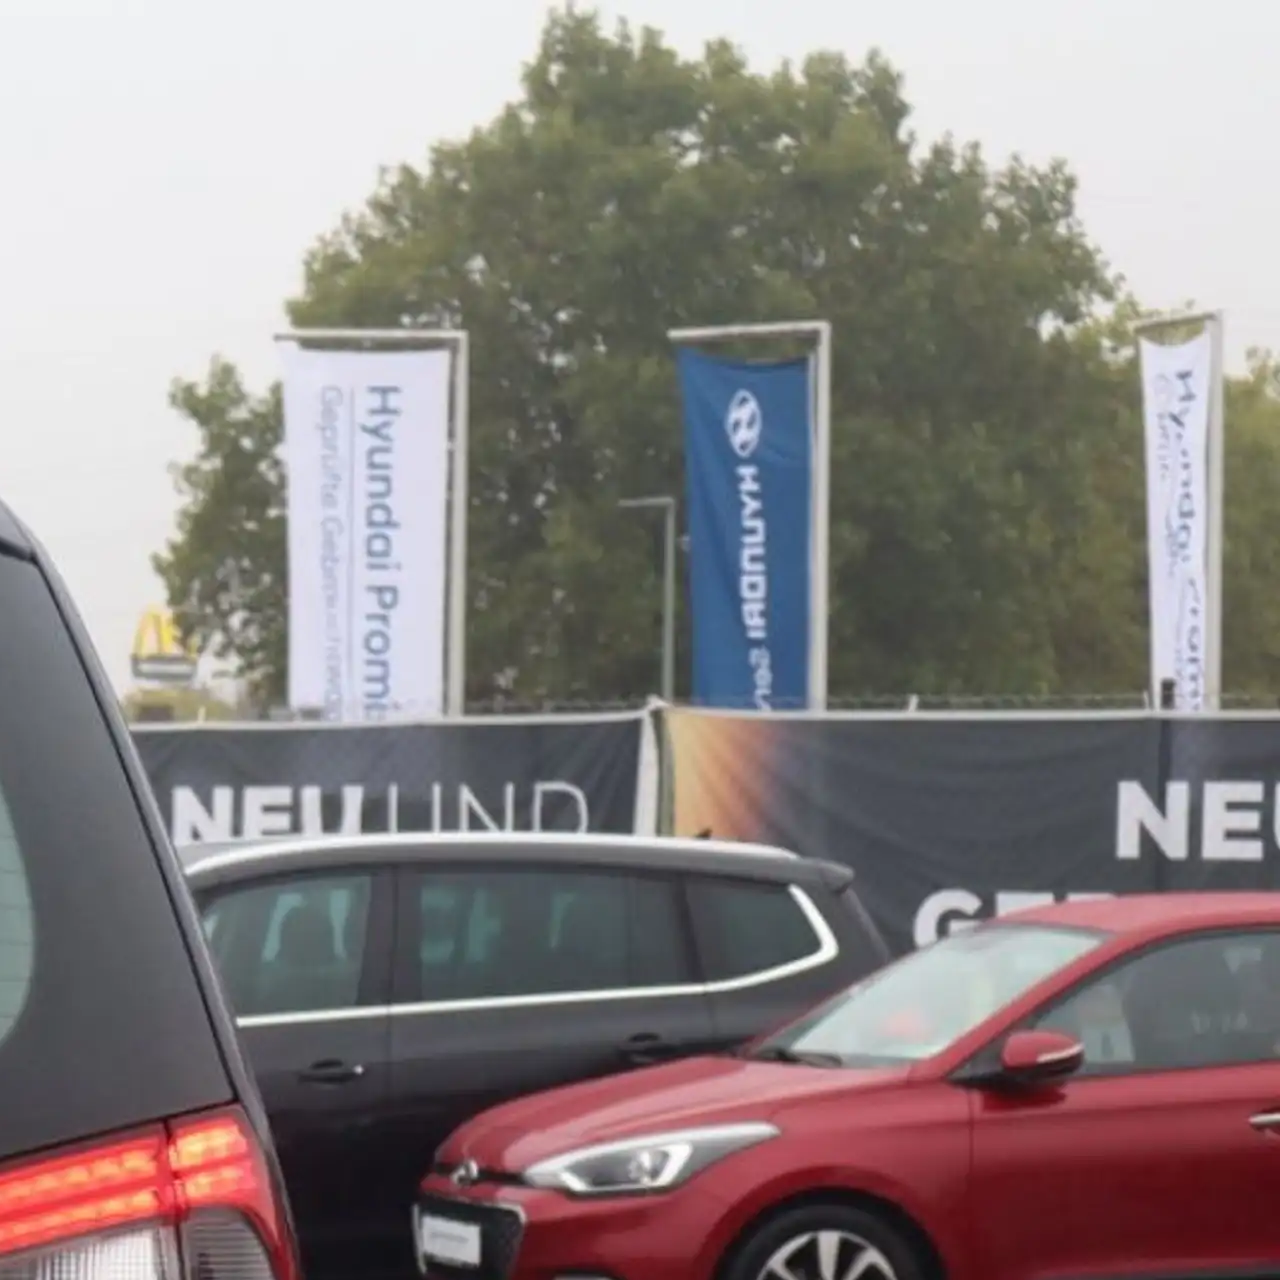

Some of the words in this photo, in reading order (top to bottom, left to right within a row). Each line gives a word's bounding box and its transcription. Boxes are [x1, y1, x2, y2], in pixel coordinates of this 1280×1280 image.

[357, 385, 403, 571] Hyundai
[172, 784, 364, 846] NEU
[1116, 779, 1280, 861] NE
